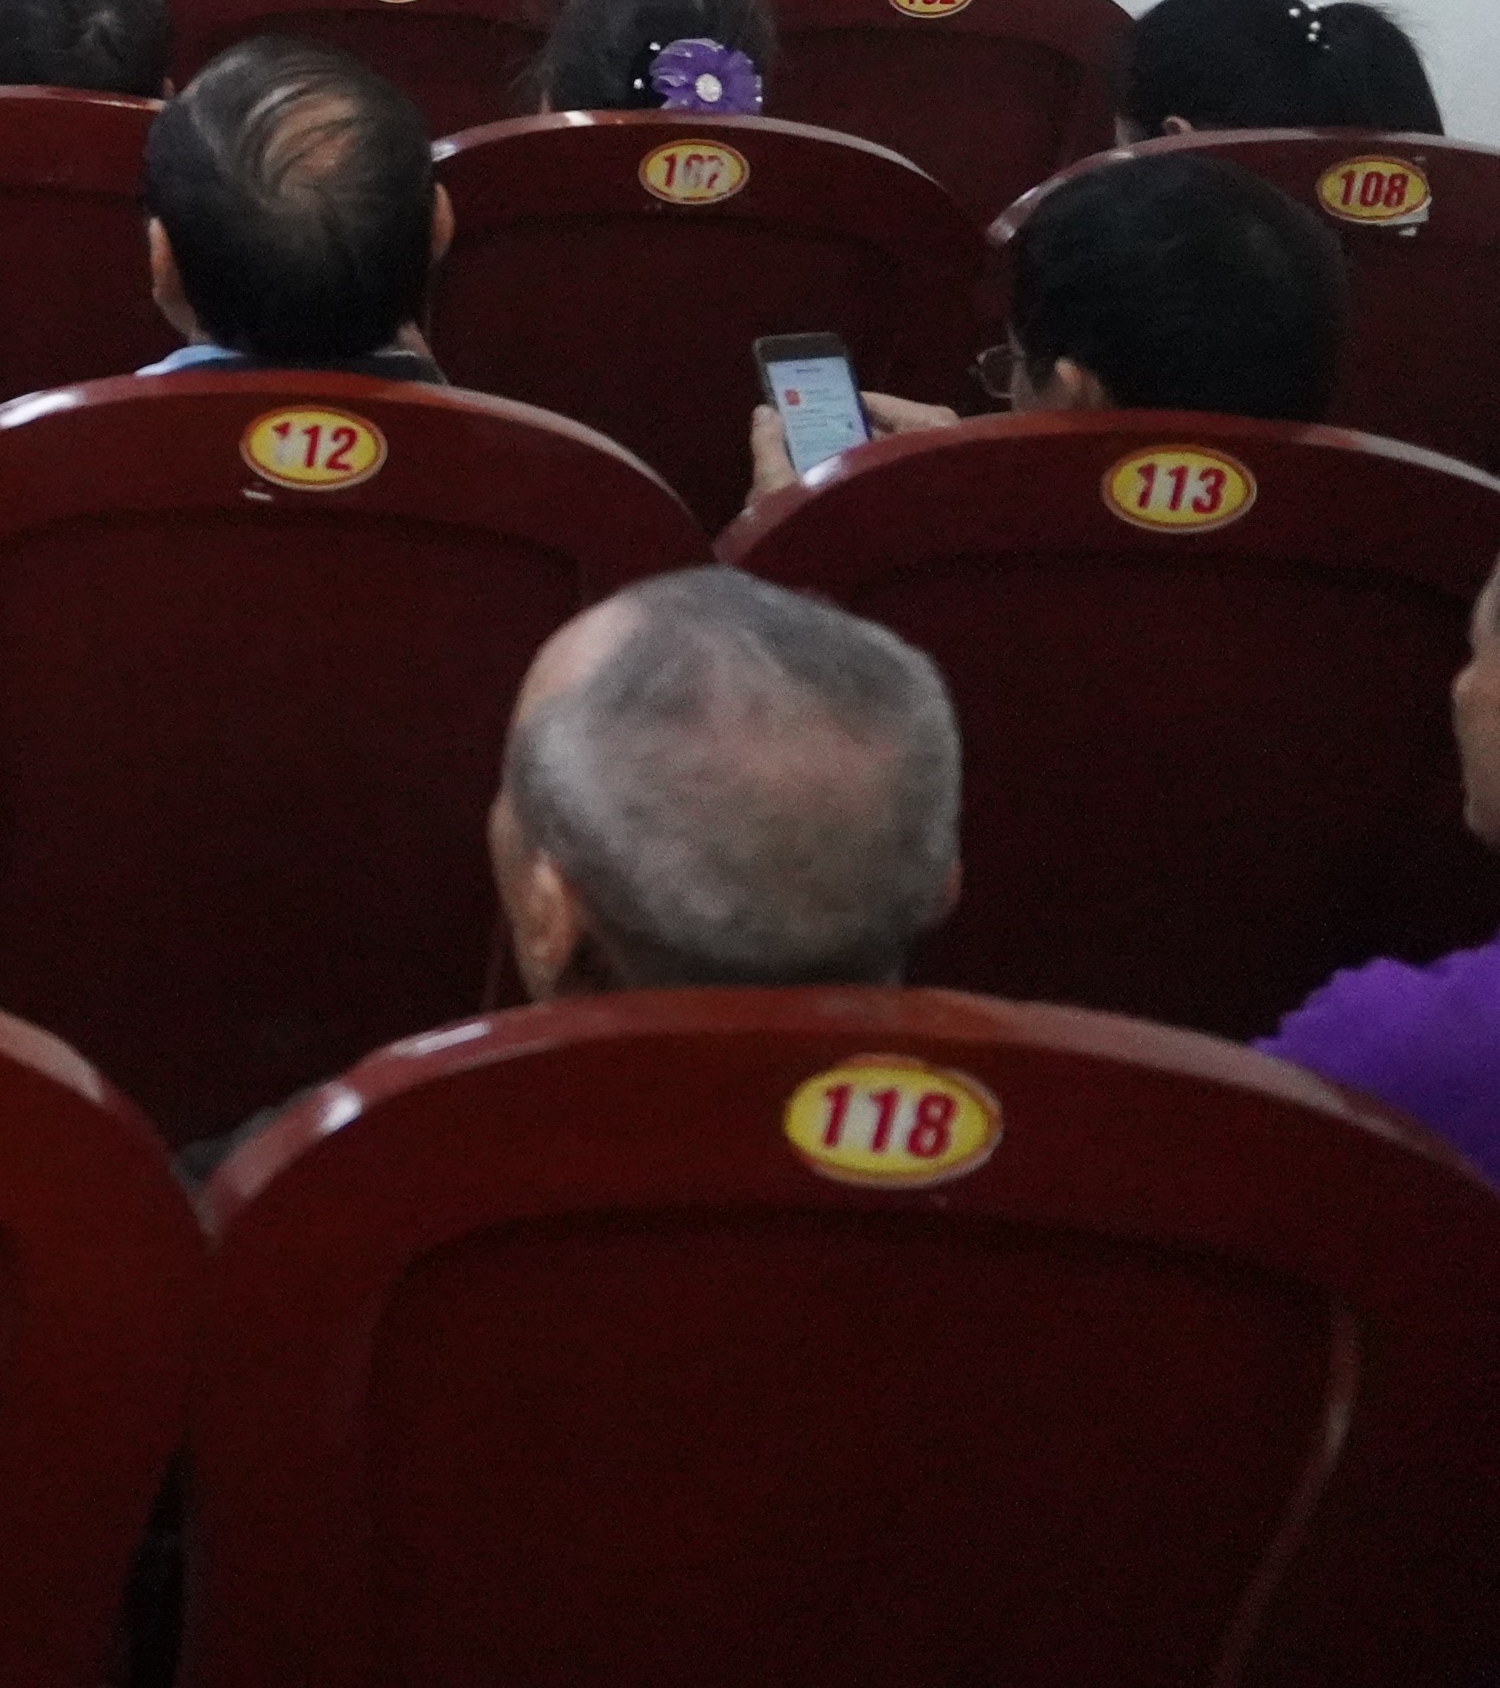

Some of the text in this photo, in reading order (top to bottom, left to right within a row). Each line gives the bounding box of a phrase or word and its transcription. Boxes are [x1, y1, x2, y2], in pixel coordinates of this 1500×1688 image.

[1339, 169, 1409, 208] 108
[1136, 462, 1225, 514] 113
[816, 1087, 954, 1158] 118
